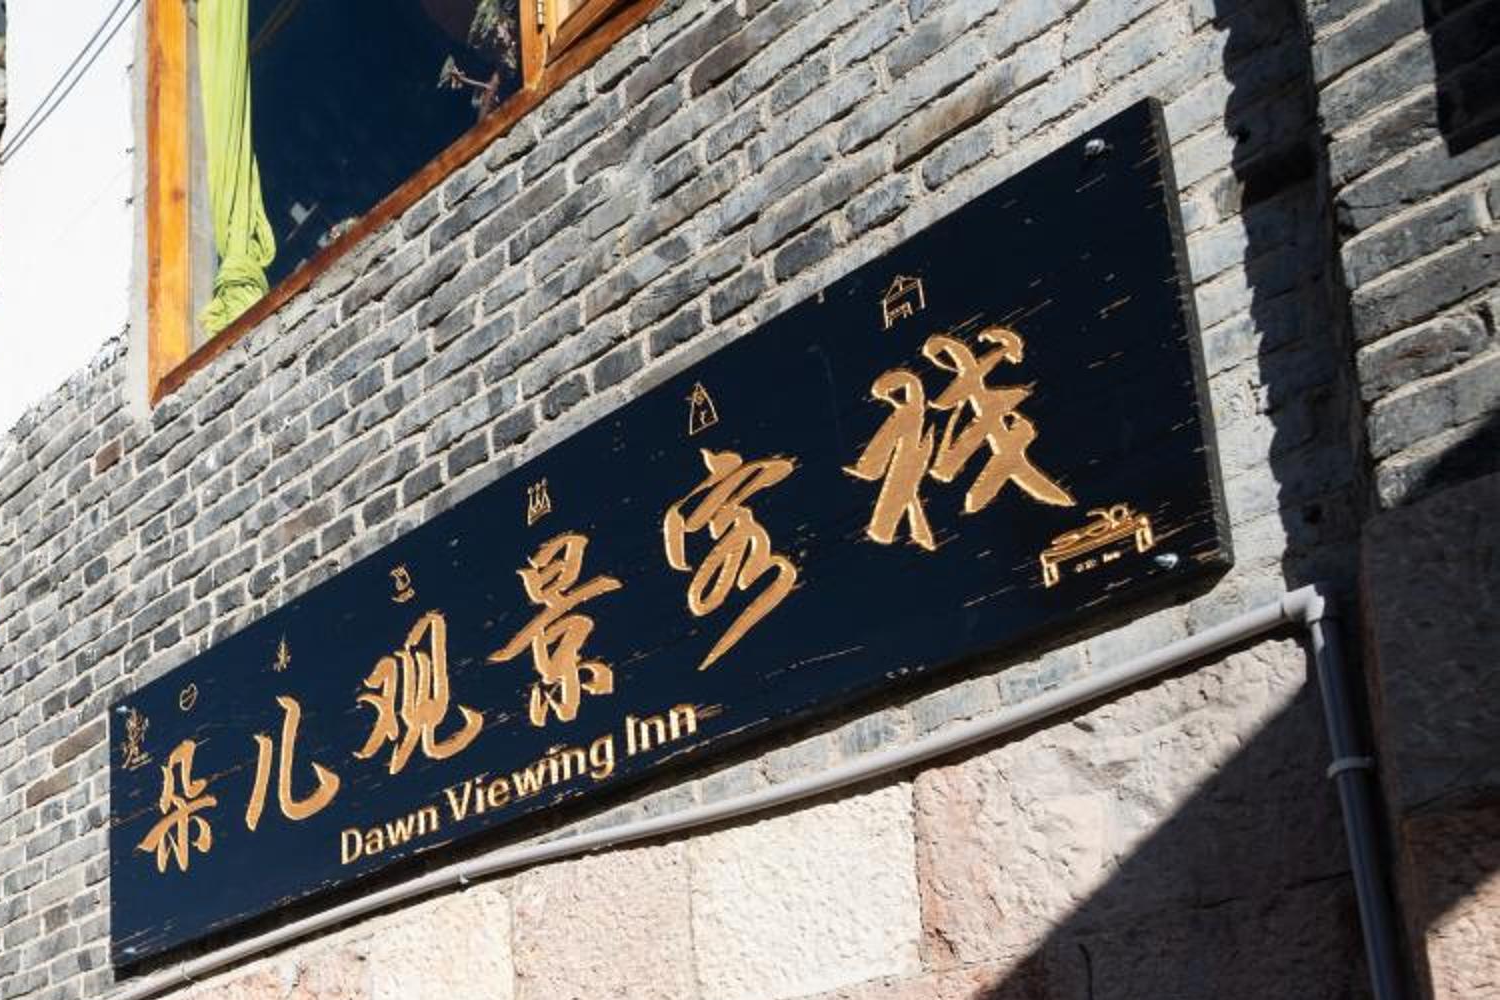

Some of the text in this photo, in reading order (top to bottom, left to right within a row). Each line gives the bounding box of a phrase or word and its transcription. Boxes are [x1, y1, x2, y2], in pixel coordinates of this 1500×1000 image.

[136, 326, 1076, 876] 朵儿观景客栈
[340, 704, 698, 865] Dawn Viewing Inn
